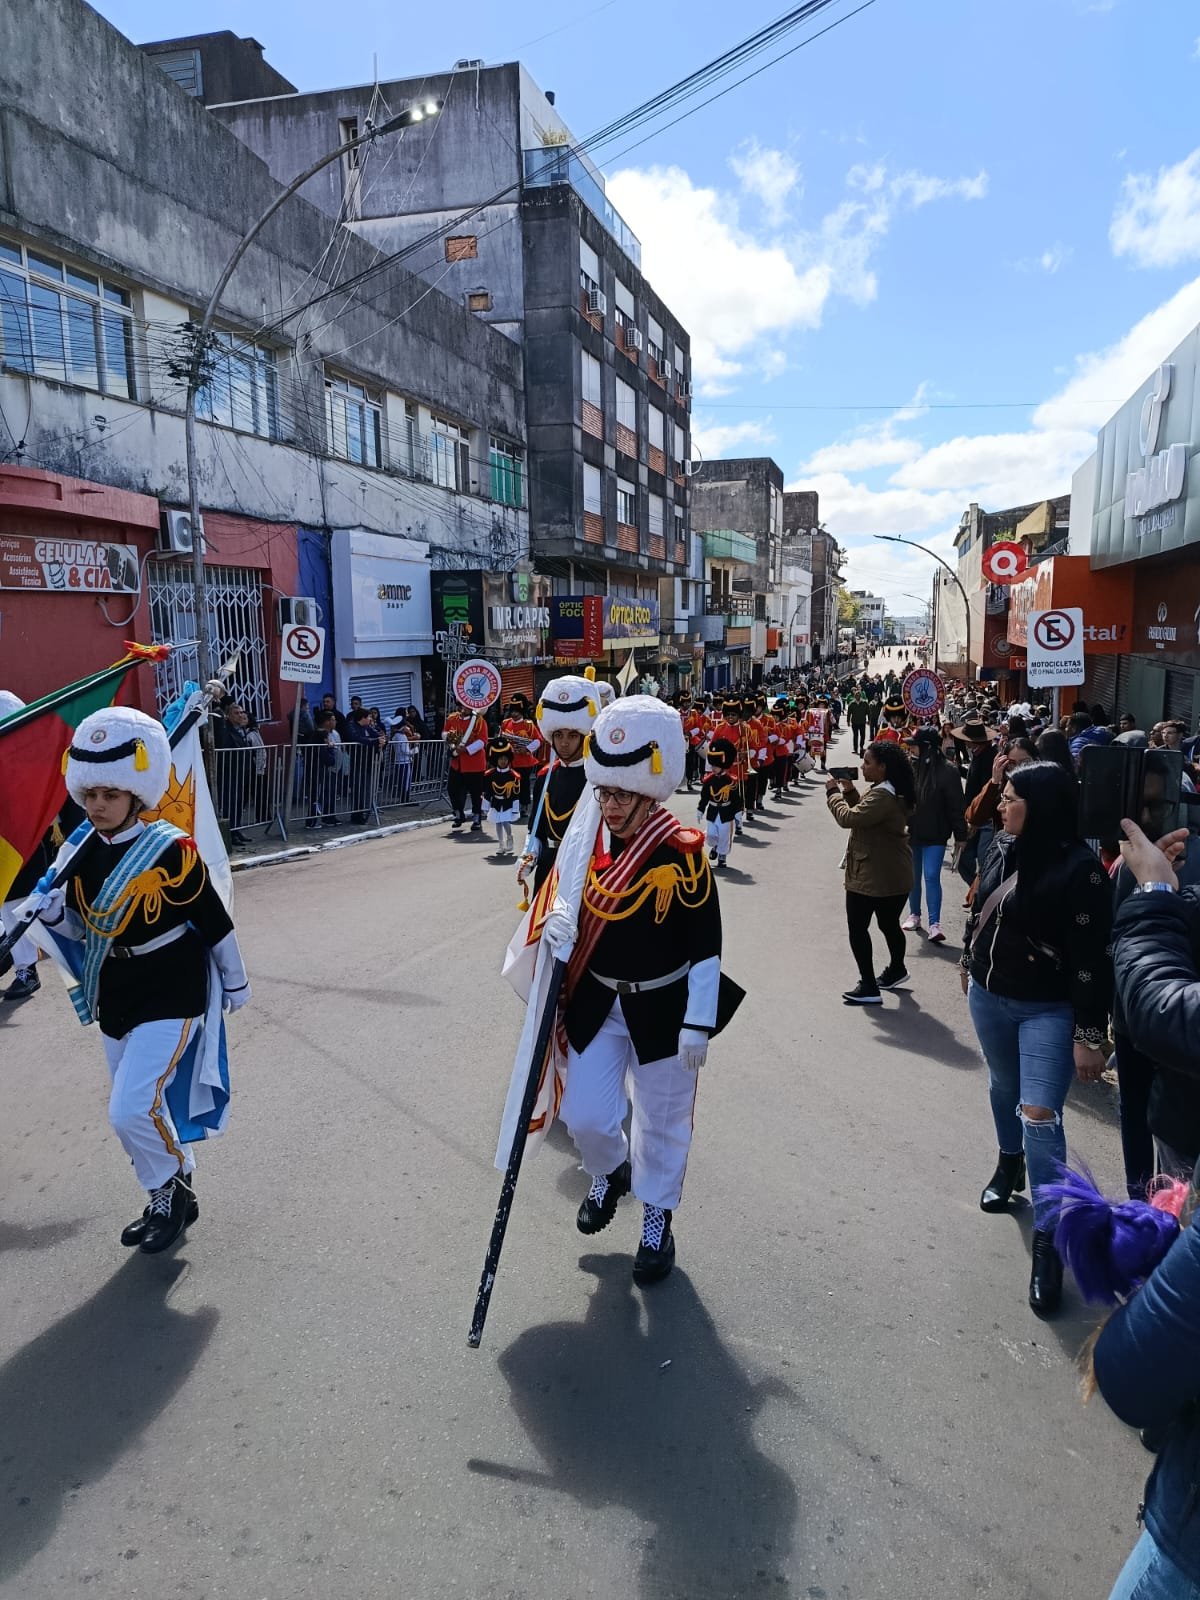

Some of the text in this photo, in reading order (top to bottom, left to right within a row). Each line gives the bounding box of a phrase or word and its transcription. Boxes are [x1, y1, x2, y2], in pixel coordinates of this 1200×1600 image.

[35, 541, 108, 565] CELULAR
[990, 550, 1017, 576] Q
[68, 567, 112, 588] & CIA
[1031, 660, 1081, 669] MOTOCICLETAS
[461, 667, 497, 692] BANDA MARCIAL
